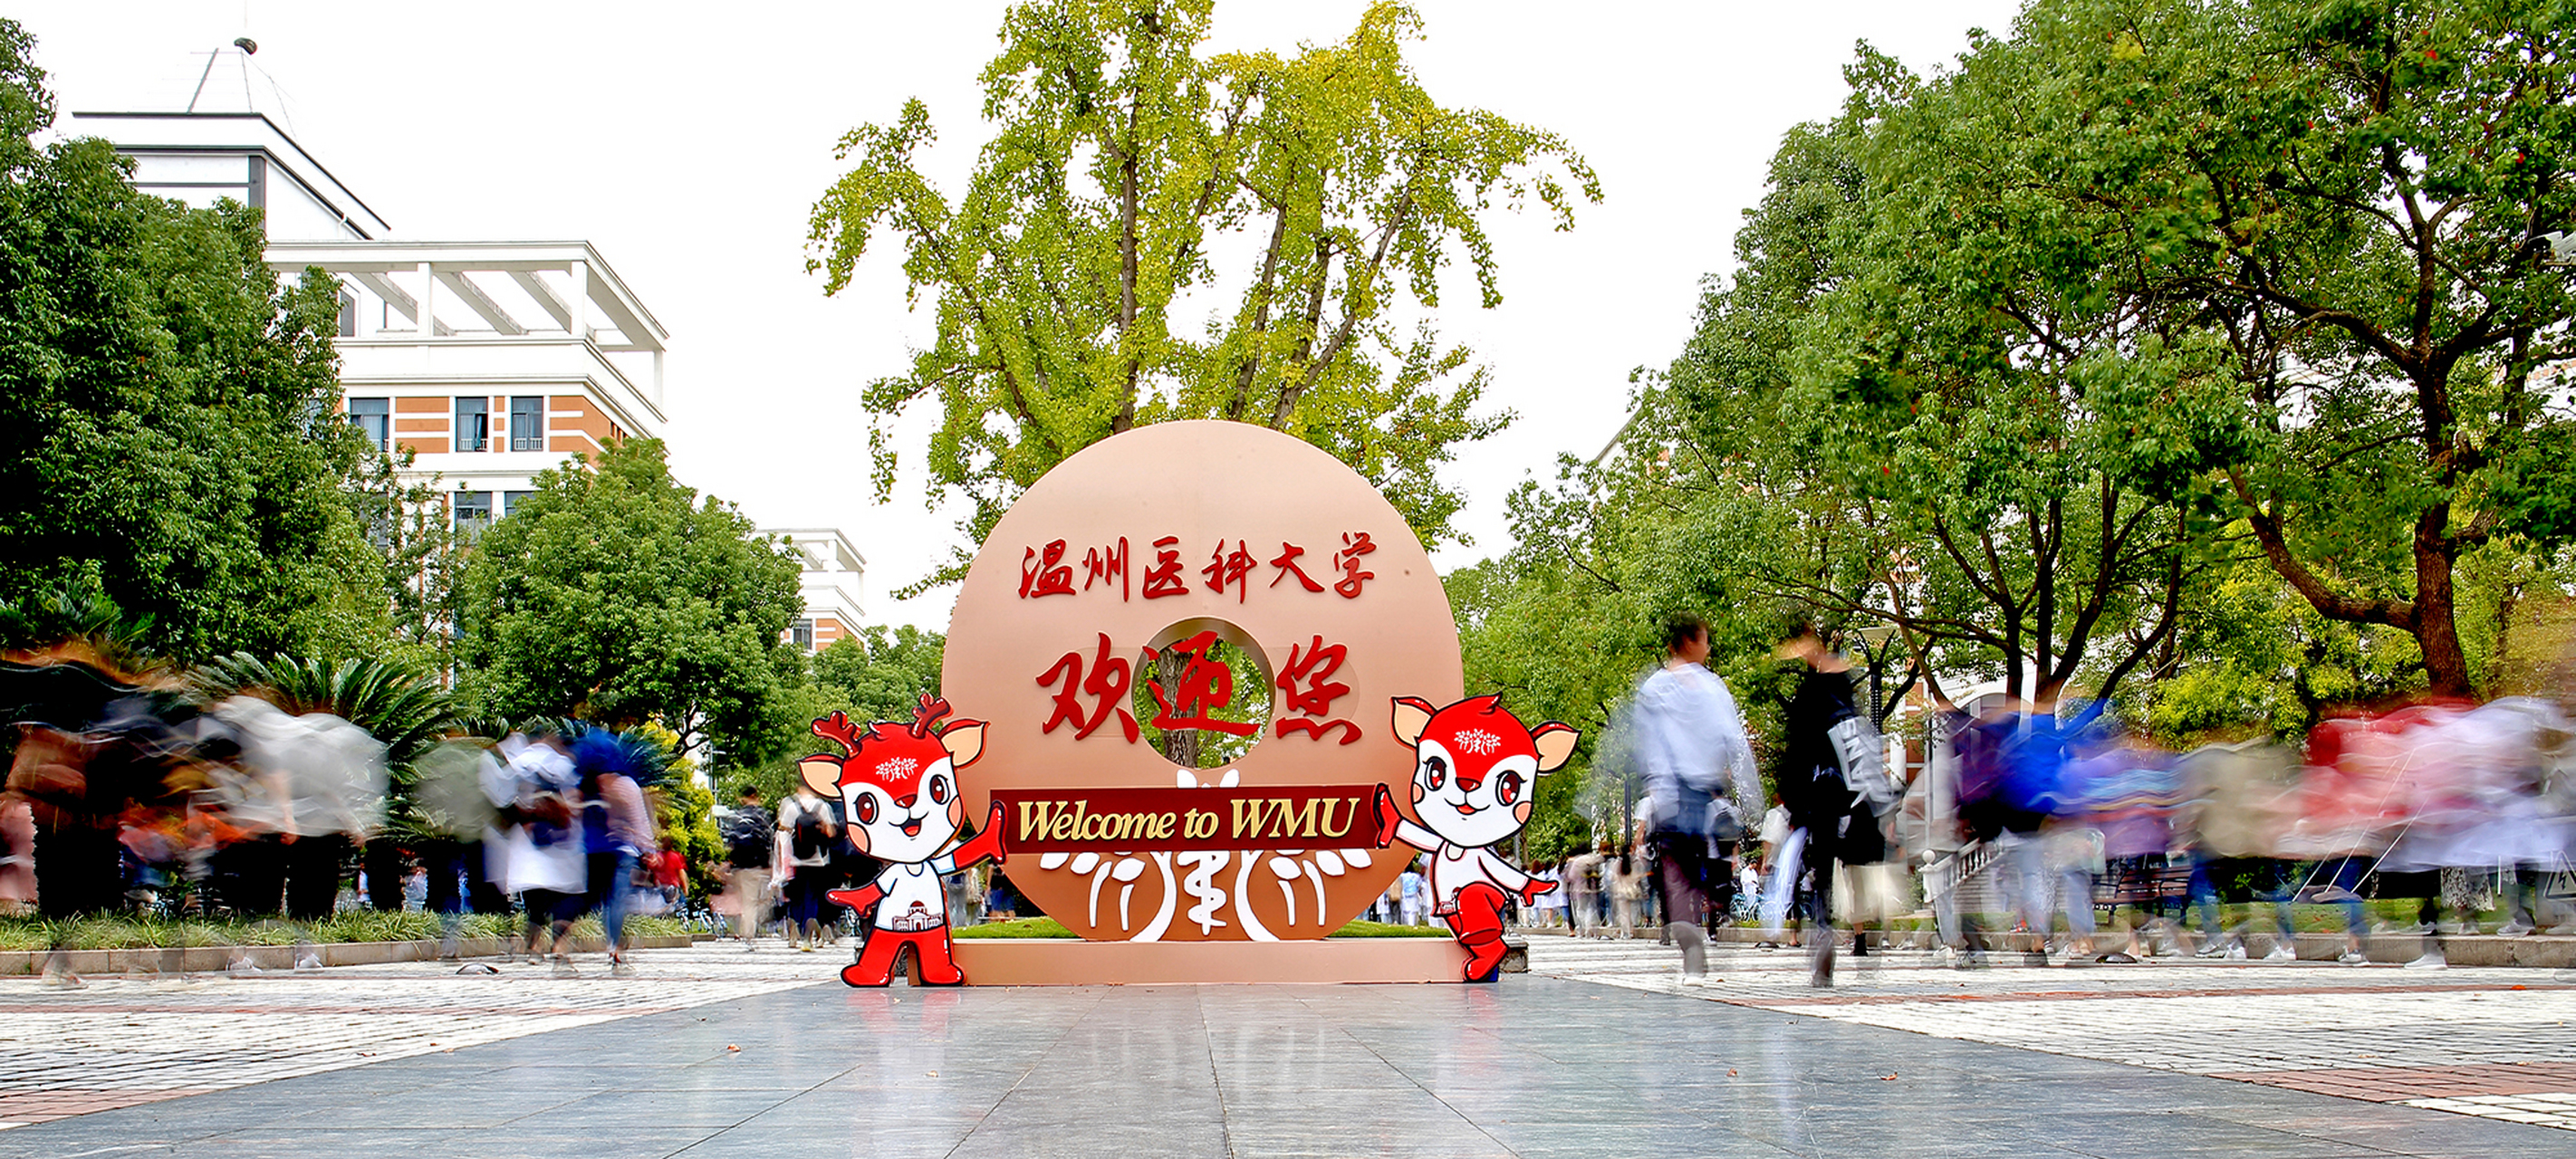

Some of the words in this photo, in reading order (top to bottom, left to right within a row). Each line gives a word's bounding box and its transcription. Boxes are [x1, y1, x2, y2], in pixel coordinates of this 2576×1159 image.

[1017, 531, 1378, 604] 温州医科大学
[1034, 630, 1363, 746] 欢迎您
[1017, 799, 1177, 842] Welcome
[1183, 807, 1219, 840] to
[1230, 797, 1361, 839] WMU
